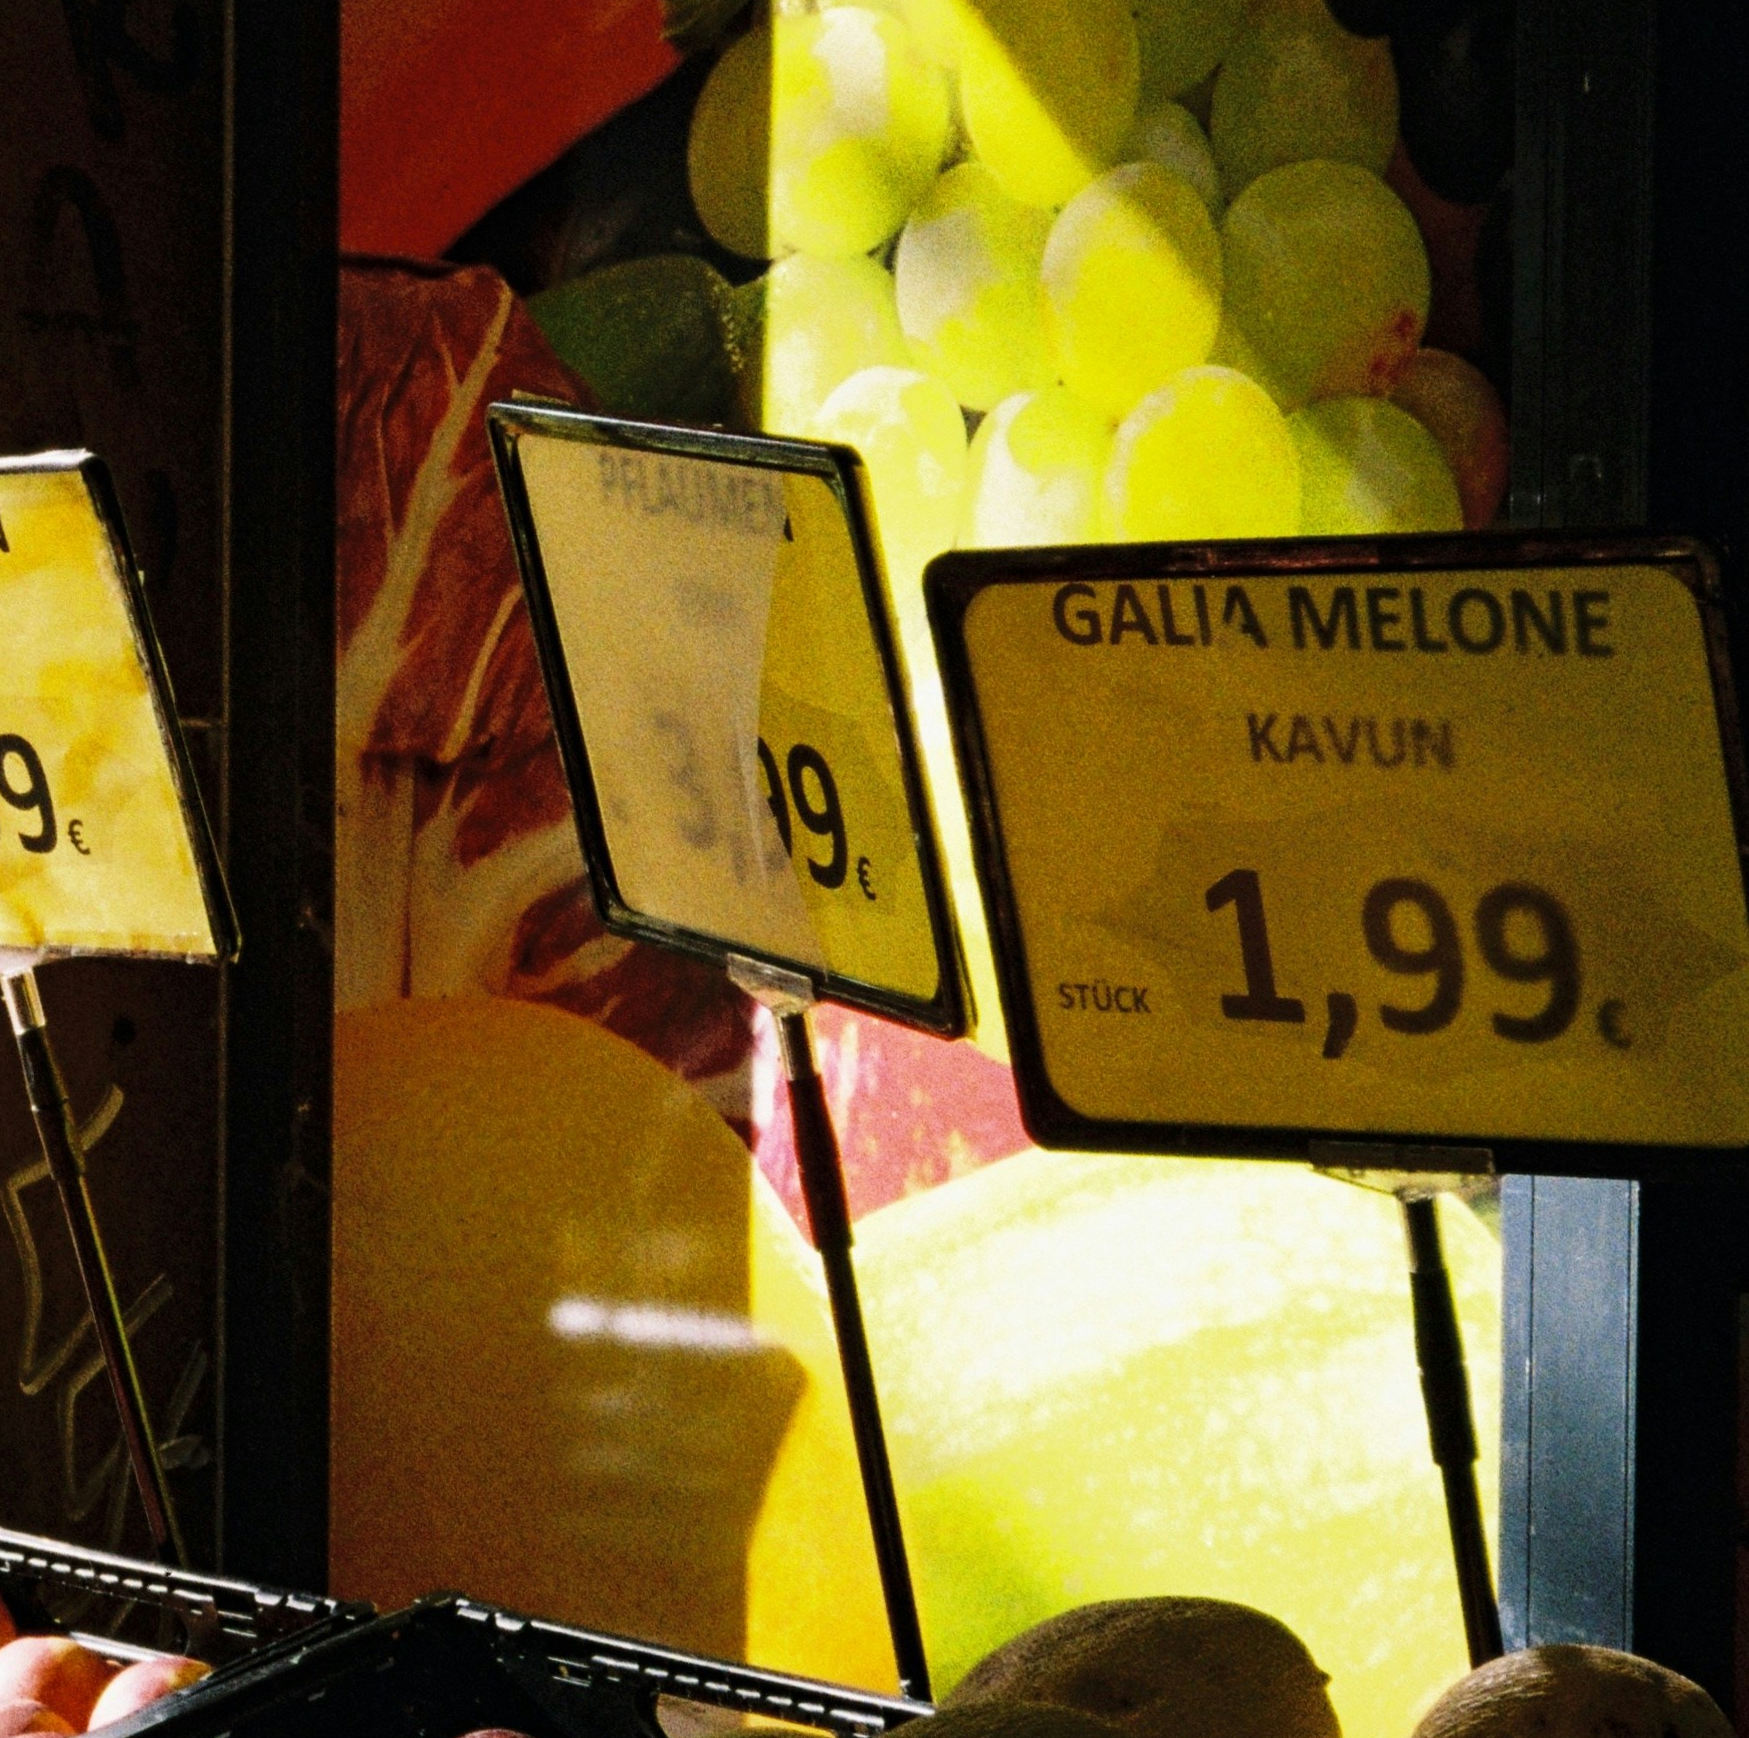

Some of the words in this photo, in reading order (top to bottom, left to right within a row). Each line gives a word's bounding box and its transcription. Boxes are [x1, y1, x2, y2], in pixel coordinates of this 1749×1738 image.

[1052, 581, 1268, 647] GALIA
[1288, 585, 1616, 659] MELONE
[1245, 711, 1457, 771] KAVUN
[1057, 979, 1151, 1015] STÜCK
